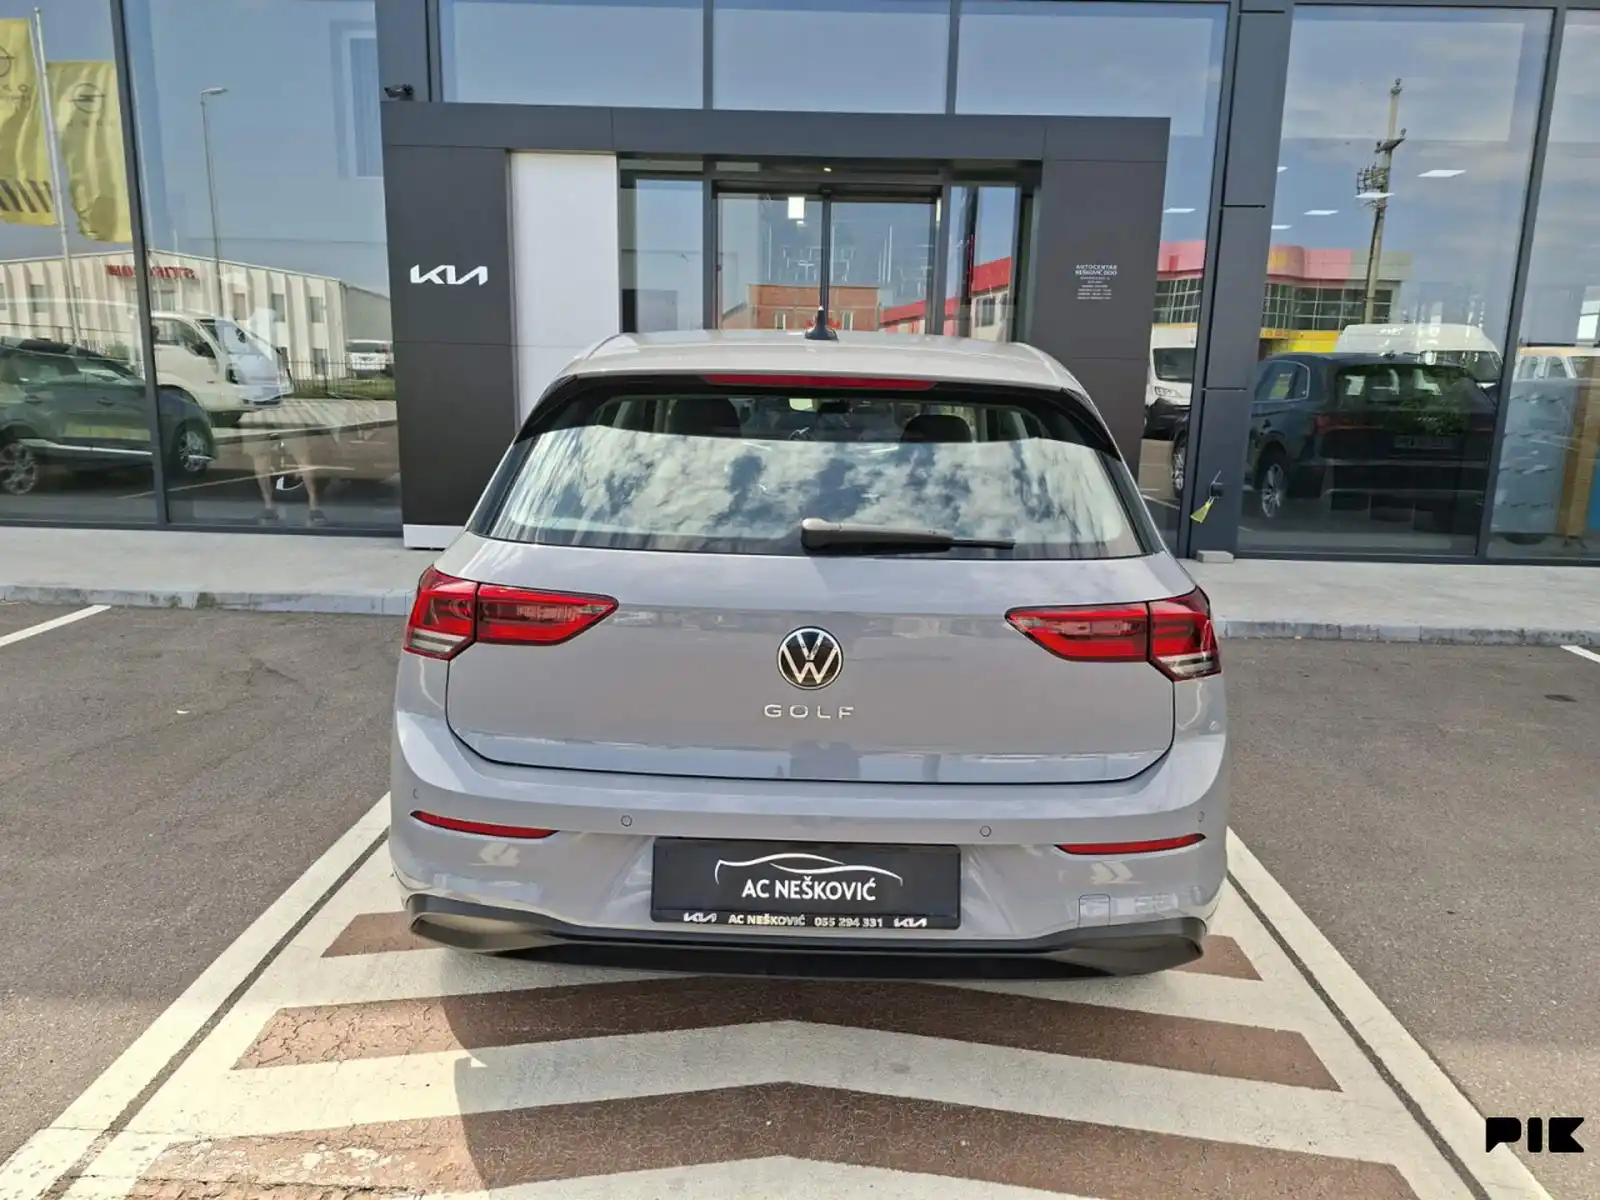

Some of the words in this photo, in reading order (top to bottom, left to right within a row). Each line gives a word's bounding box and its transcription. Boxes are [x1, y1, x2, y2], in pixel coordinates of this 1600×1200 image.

[410, 264, 488, 285] KIA
[764, 703, 854, 719] GOLF
[741, 879, 770, 898] AC
[774, 875, 876, 901] NEŠKOVIĆ
[683, 912, 717, 922] KIA
[728, 914, 744, 924] AC
[747, 913, 806, 926] NEŠKOVIĆ
[814, 917, 836, 927] 055
[862, 917, 883, 927] 331
[893, 917, 928, 928] KIA
